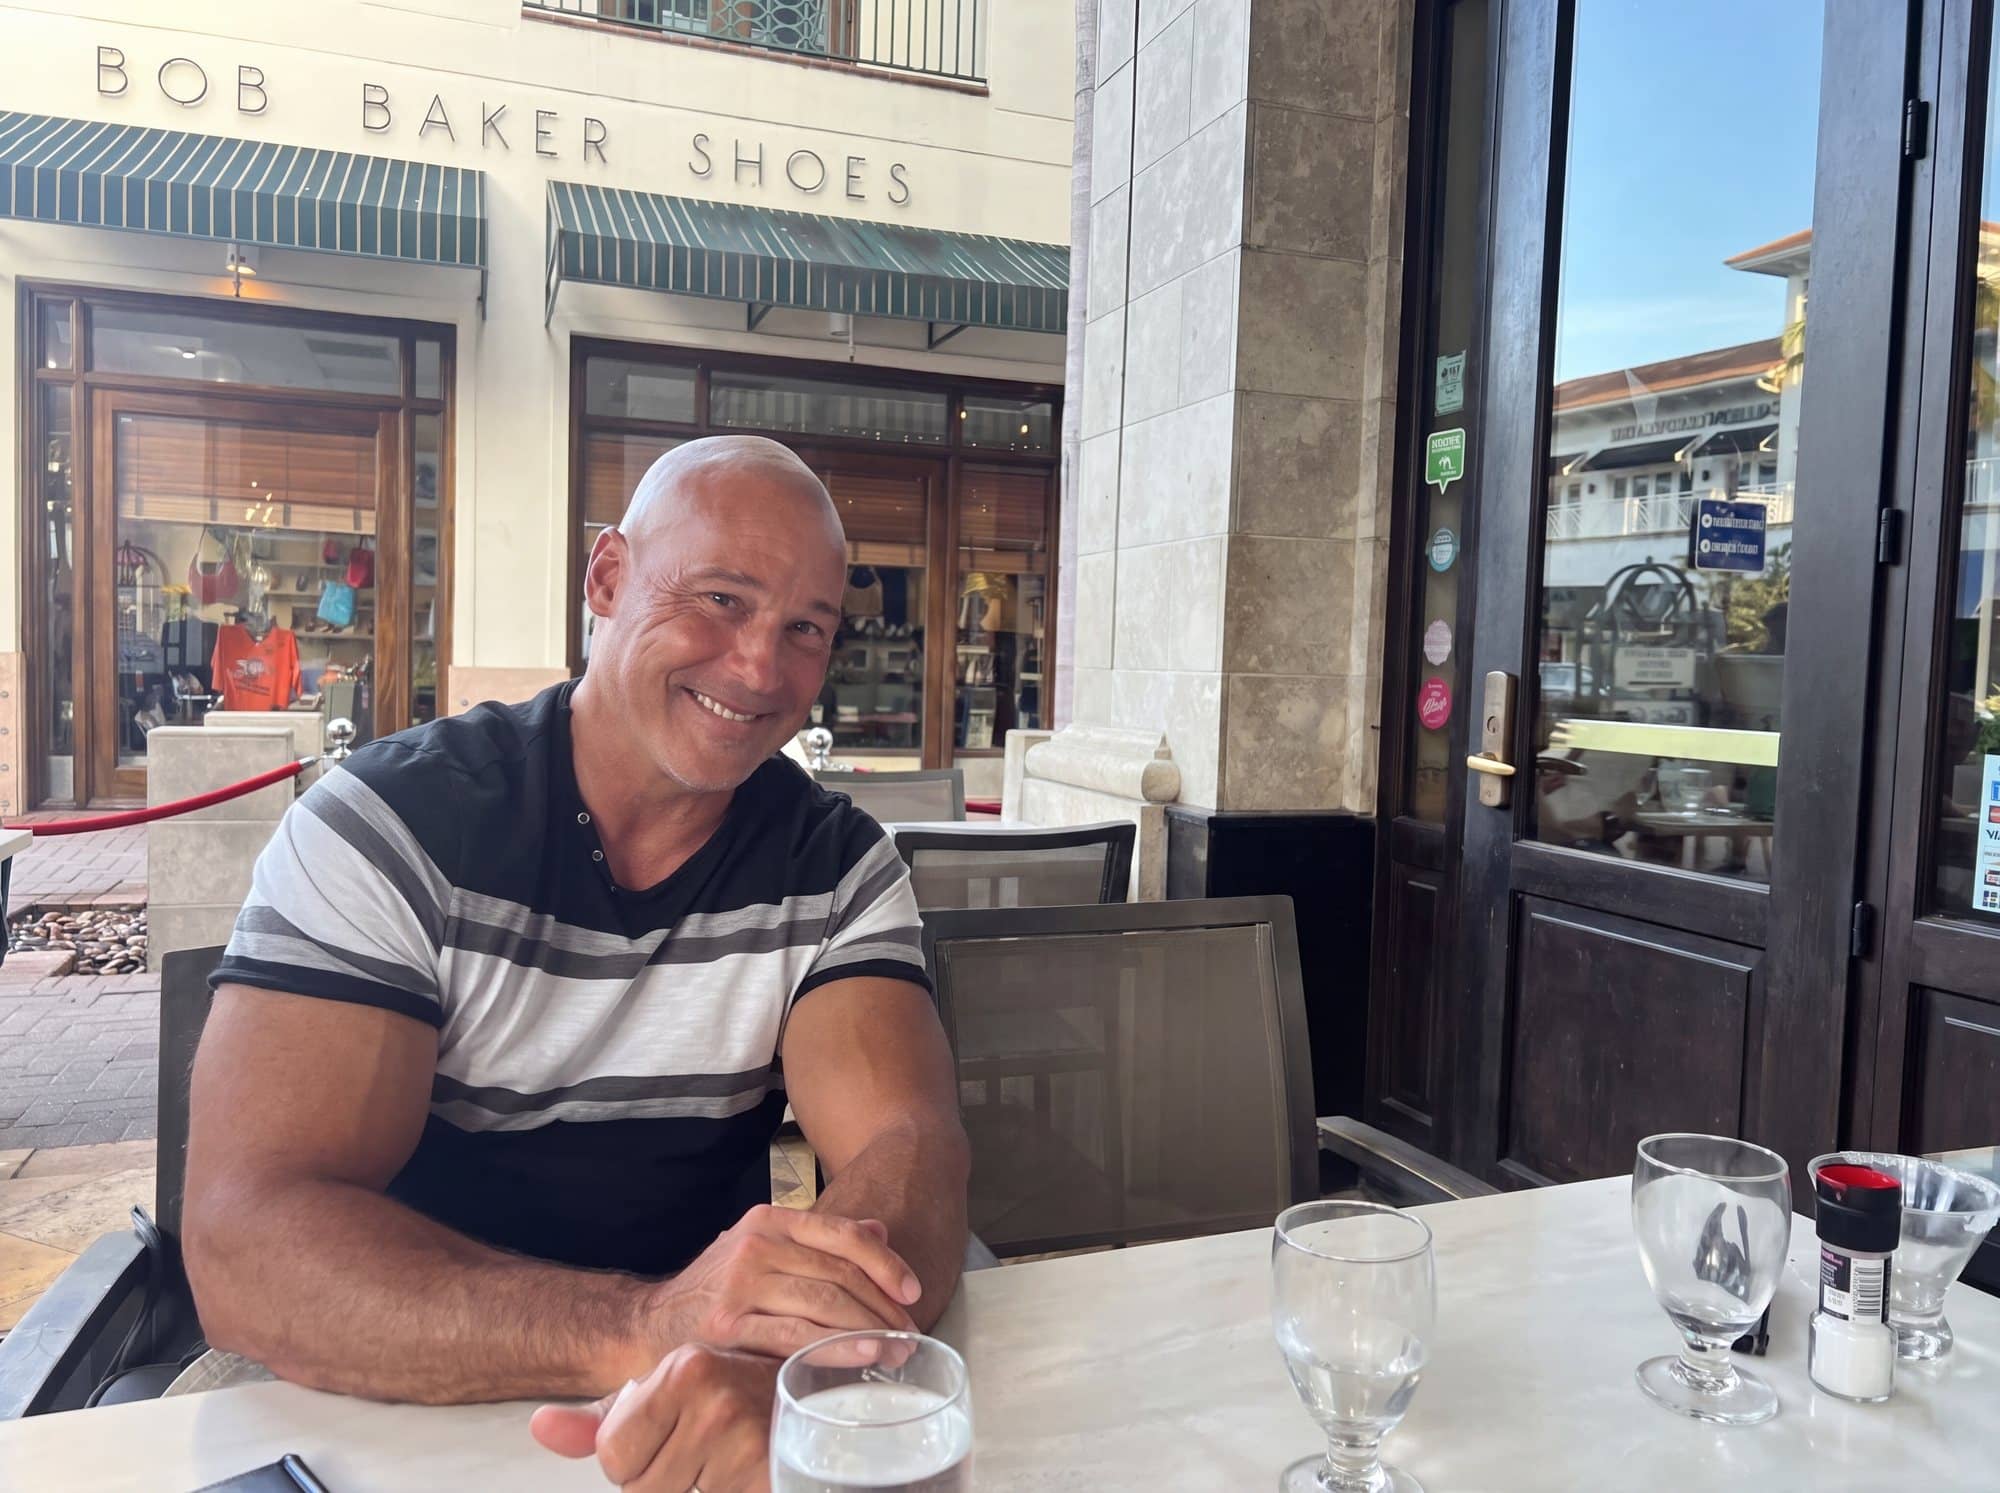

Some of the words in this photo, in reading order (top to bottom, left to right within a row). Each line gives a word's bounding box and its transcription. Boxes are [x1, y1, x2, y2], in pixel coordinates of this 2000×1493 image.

[97, 45, 269, 113] BOB
[363, 83, 608, 163] BAKER
[688, 133, 910, 204] SHOES
[1986, 829, 2000, 841] VI
